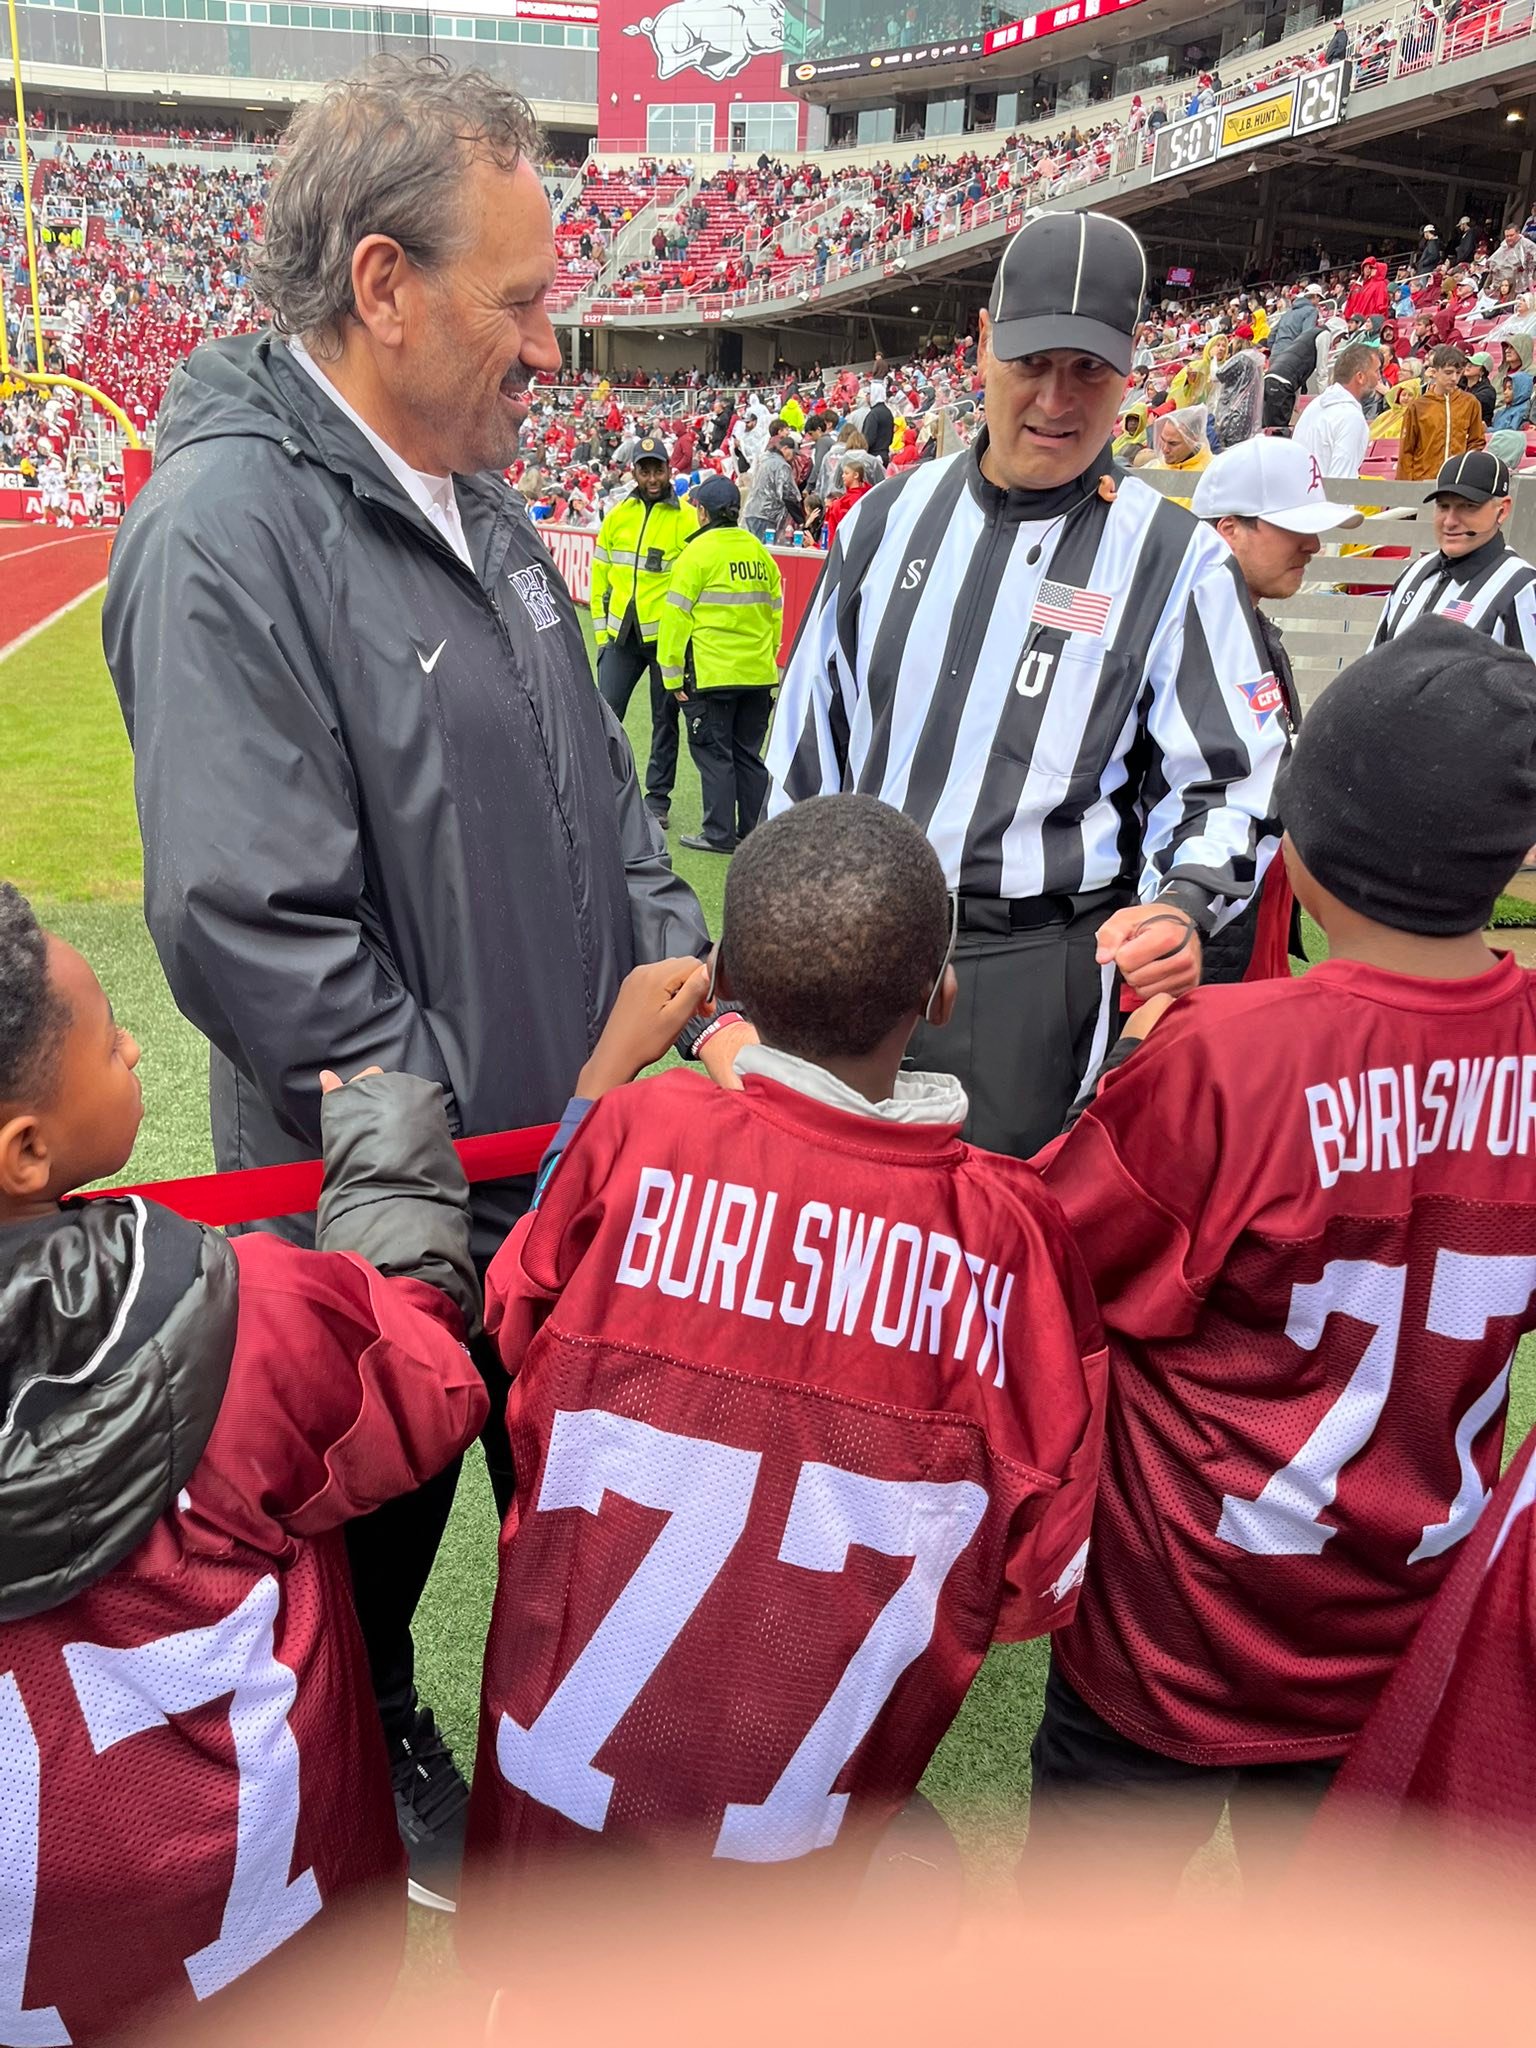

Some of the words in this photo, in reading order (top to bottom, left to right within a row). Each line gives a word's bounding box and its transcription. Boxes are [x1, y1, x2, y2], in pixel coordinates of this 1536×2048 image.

[1253, 109, 1277, 127] HUNT
[1301, 72, 1336, 125] 25
[1015, 649, 1055, 698] U
[615, 1166, 1015, 1389] BURLSWORTH
[496, 1408, 990, 1864] 77
